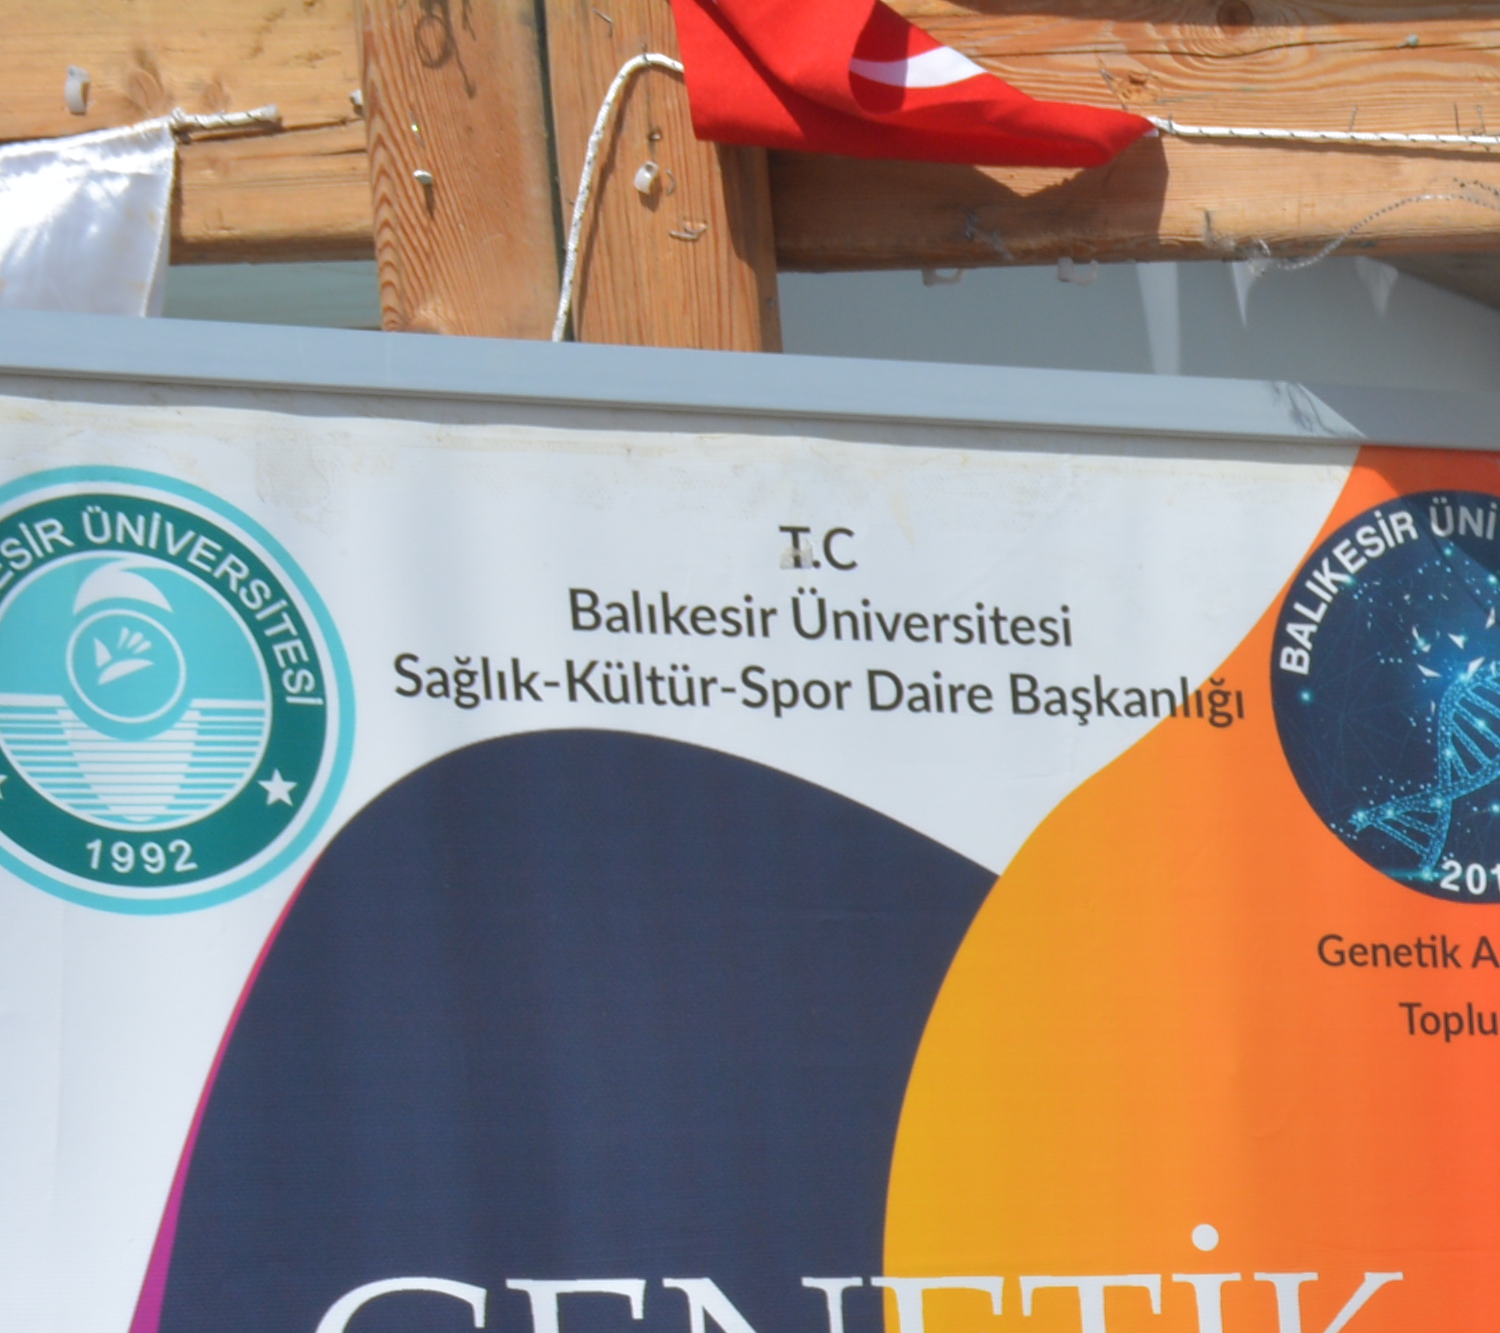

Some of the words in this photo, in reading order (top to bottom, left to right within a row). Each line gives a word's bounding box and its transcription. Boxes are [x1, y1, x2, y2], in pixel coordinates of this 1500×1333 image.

[778, 525, 858, 571] T.C
[82, 505, 323, 707] ÜNİVERSİTESİ
[568, 587, 778, 640] Balıkesir
[791, 592, 1073, 648] Üniversitesi
[1279, 509, 1418, 676] BALIKESİR
[393, 653, 852, 718] Sağlık-Kültür-Spor
[868, 672, 993, 716] Daire
[1010, 673, 1245, 728] Başkanlığı
[84, 838, 198, 875] 1992
[1316, 934, 1462, 969] Genetik
